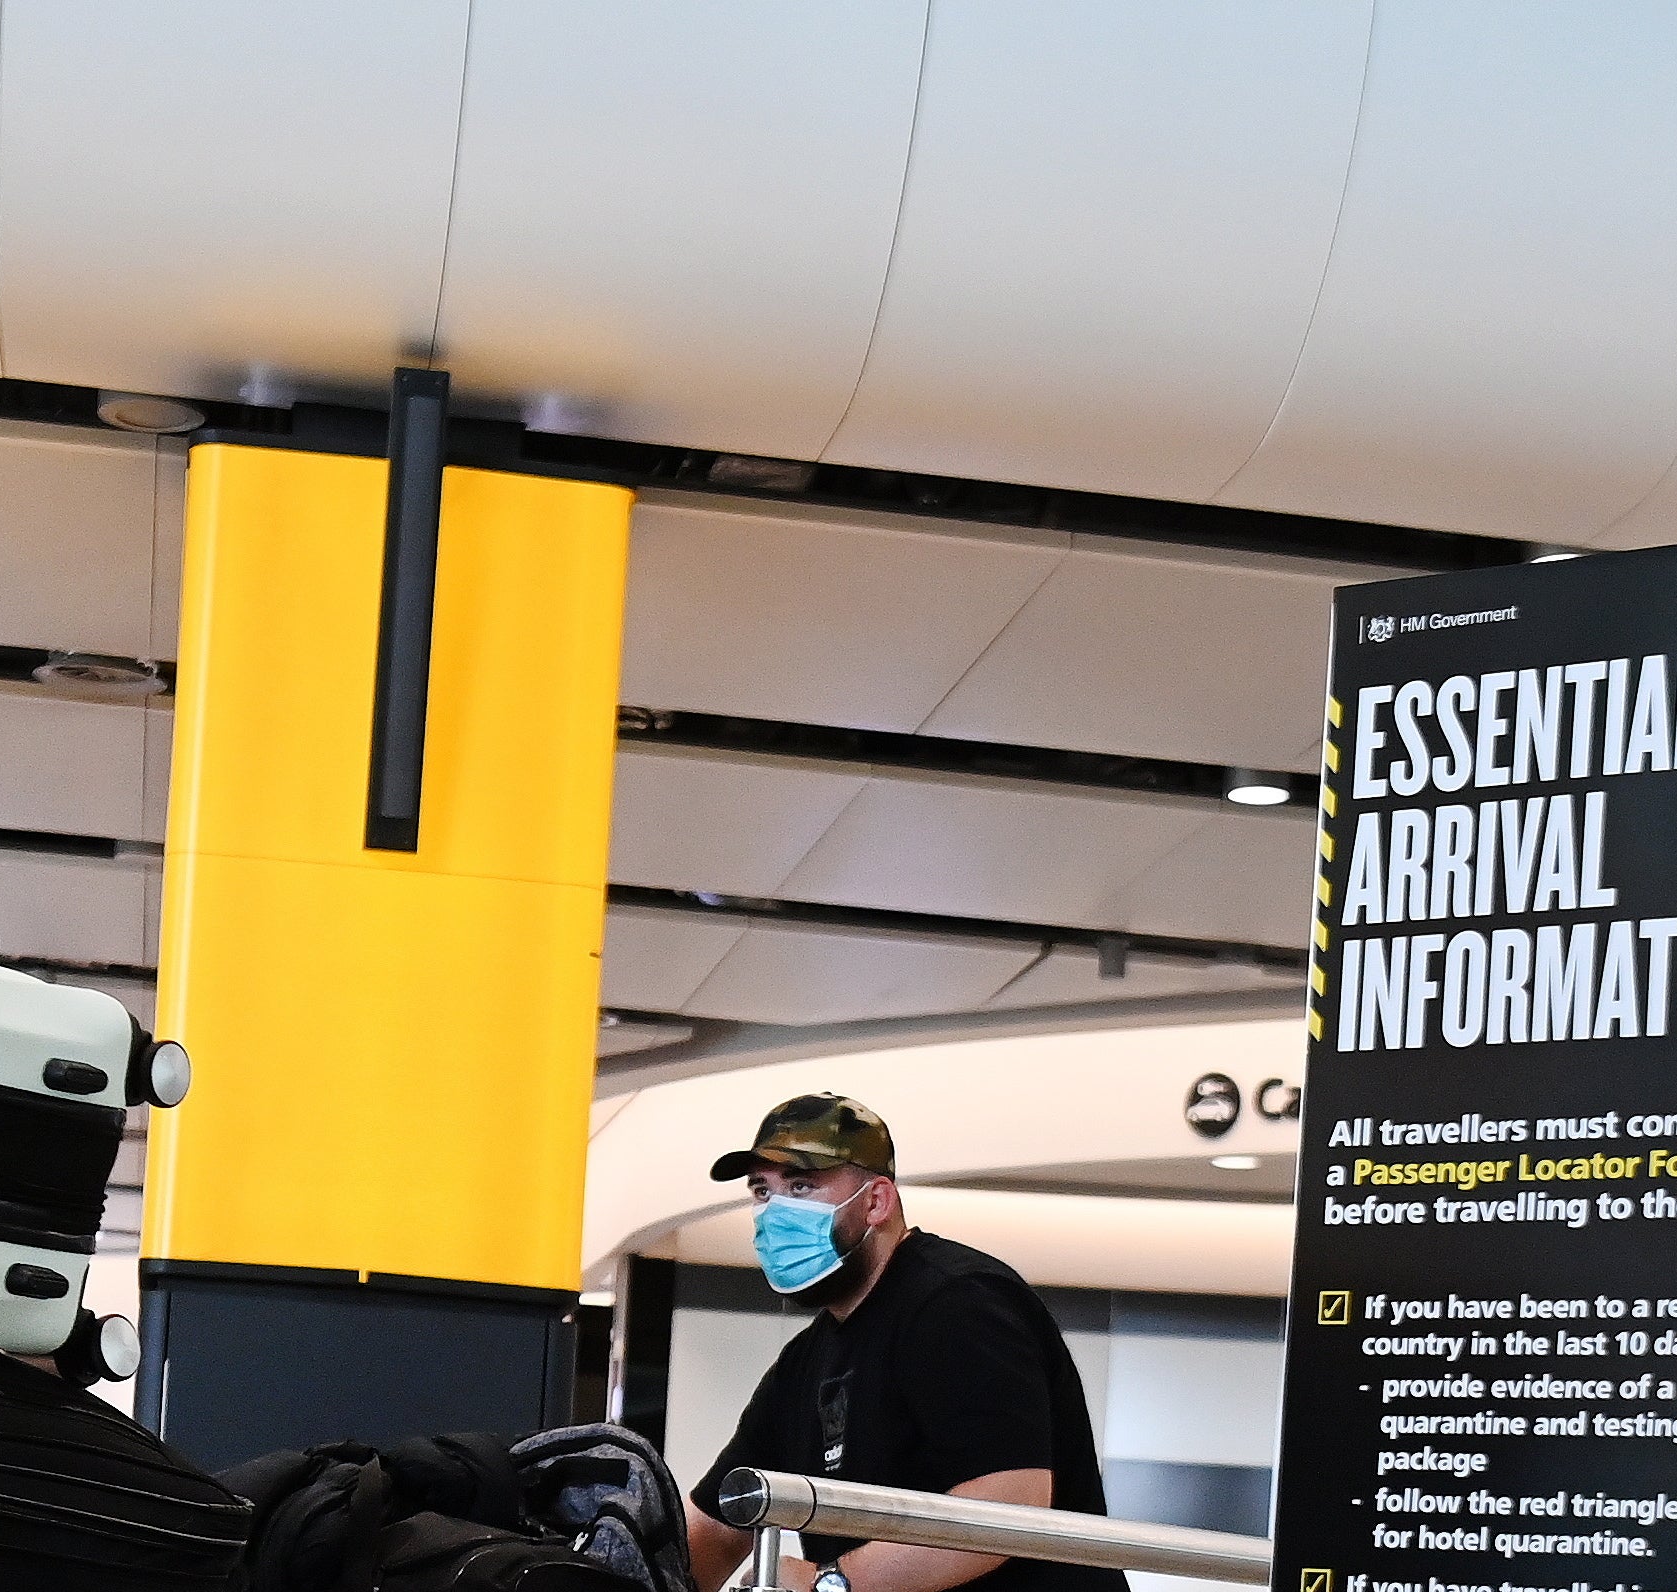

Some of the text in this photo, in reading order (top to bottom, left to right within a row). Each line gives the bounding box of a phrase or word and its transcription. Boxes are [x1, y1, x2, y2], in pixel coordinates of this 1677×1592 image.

[1401, 606, 1517, 633] HM Government
[1342, 791, 1617, 925] ARRIVAL
[1328, 1118, 1373, 1147] All
[1379, 1114, 1528, 1145] travellers
[1536, 1111, 1620, 1140] must
[1327, 1166, 1345, 1186] a
[1353, 1159, 1511, 1190] Passenger
[1518, 1153, 1641, 1180] Locator
[1324, 1196, 1426, 1224] before
[1433, 1192, 1589, 1228] travelling
[1596, 1193, 1635, 1219] to
[1365, 1294, 1386, 1319] If
[1391, 1301, 1442, 1325] you
[1448, 1294, 1514, 1318] have
[1520, 1294, 1589, 1318] been
[1594, 1295, 1626, 1318] to
[1632, 1299, 1650, 1317] a
[1362, 1333, 1466, 1361] country
[1471, 1331, 1497, 1355] in
[1503, 1331, 1550, 1355] the
[1557, 1330, 1607, 1355] last
[1615, 1332, 1649, 1355] 10
[1383, 1373, 1484, 1403] provide
[1491, 1374, 1614, 1398] evidence
[1619, 1374, 1653, 1399] of
[1657, 1381, 1676, 1399] a
[1380, 1410, 1528, 1439] quarantine
[1533, 1411, 1587, 1436] and
[1378, 1446, 1488, 1477] package
[1375, 1487, 1462, 1513] follow
[1467, 1490, 1513, 1515] the
[1519, 1491, 1566, 1516] red
[1372, 1523, 1654, 1558] for hotel quarantine.
